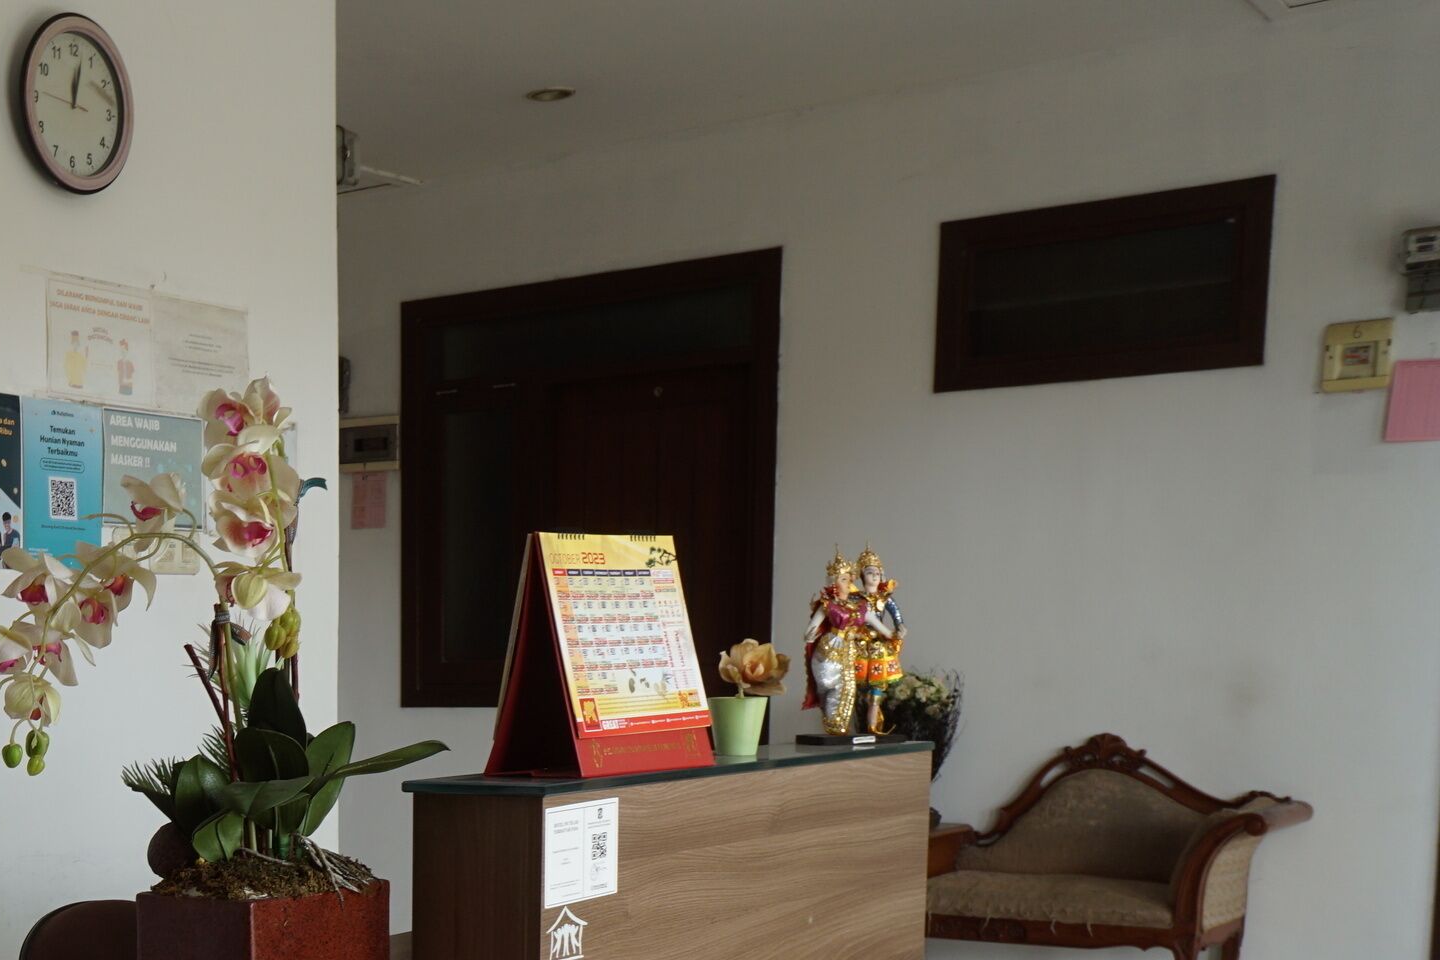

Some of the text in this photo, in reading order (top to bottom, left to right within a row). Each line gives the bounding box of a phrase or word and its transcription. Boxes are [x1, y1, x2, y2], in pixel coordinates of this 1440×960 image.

[51, 46, 61, 60] 11
[68, 43, 79, 57] 12
[38, 62, 49, 76] 10
[88, 56, 93, 69] 1
[106, 109, 112, 122] 3
[38, 120, 45, 133] 8
[99, 136, 106, 149] 4
[52, 145, 59, 158] 7
[69, 156, 76, 168] 6
[86, 153, 93, 166] 5
[110, 414, 160, 431] AREA WAJIB
[50, 425, 76, 435] Temukan
[40, 435, 84, 447] Hunian Nyaman
[111, 435, 177, 452] MENGGUNAKAN
[48, 447, 78, 456] Terbaikmu
[110, 453, 150, 468] MASKER !!
[582, 552, 606, 564] 2023
